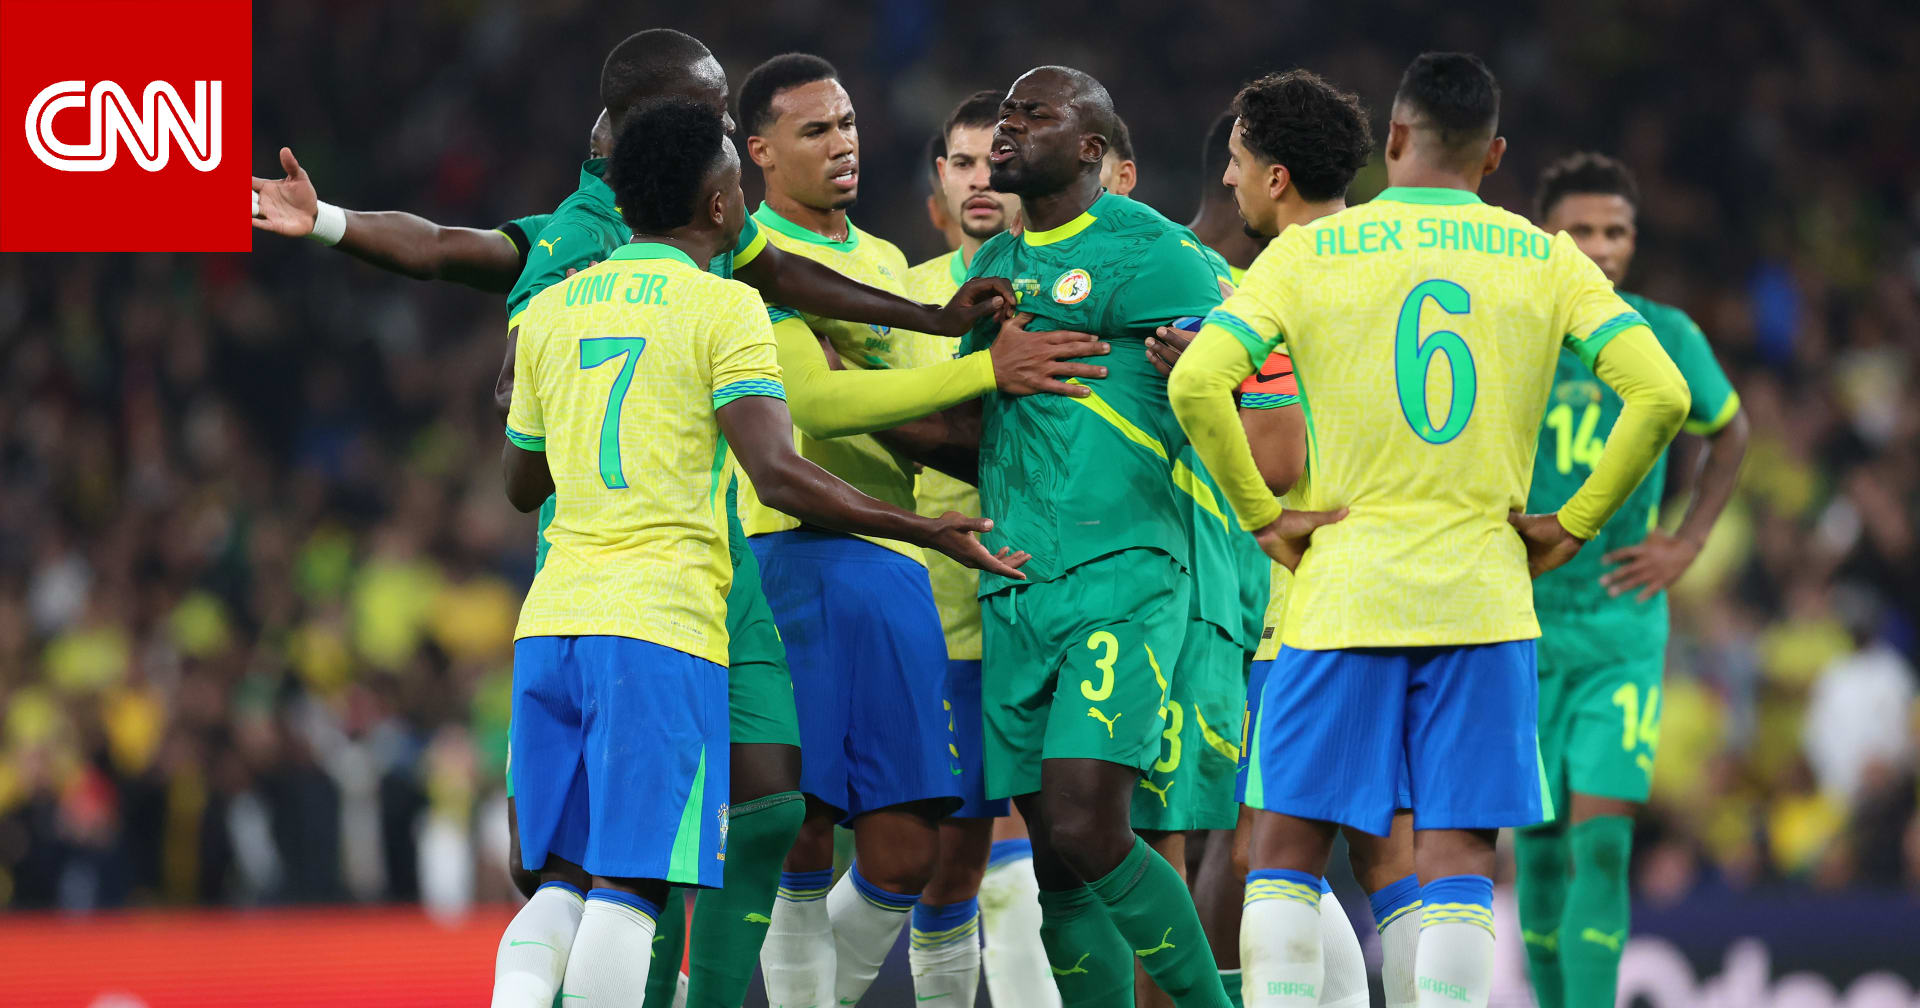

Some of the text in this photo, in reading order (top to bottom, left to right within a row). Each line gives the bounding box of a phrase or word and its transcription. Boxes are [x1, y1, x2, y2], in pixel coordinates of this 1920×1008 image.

[1316, 218, 1550, 260] ALEX SANDRO
[565, 272, 669, 307] VINI JR.
[1395, 279, 1477, 445] 6
[579, 337, 646, 489] 7
[1546, 403, 1605, 475] 14
[1080, 631, 1119, 701] 3
[1154, 700, 1184, 773] 3
[1612, 682, 1661, 752] 14
[1267, 981, 1317, 999] BRASIL
[1418, 976, 1472, 1003] BRASIL
